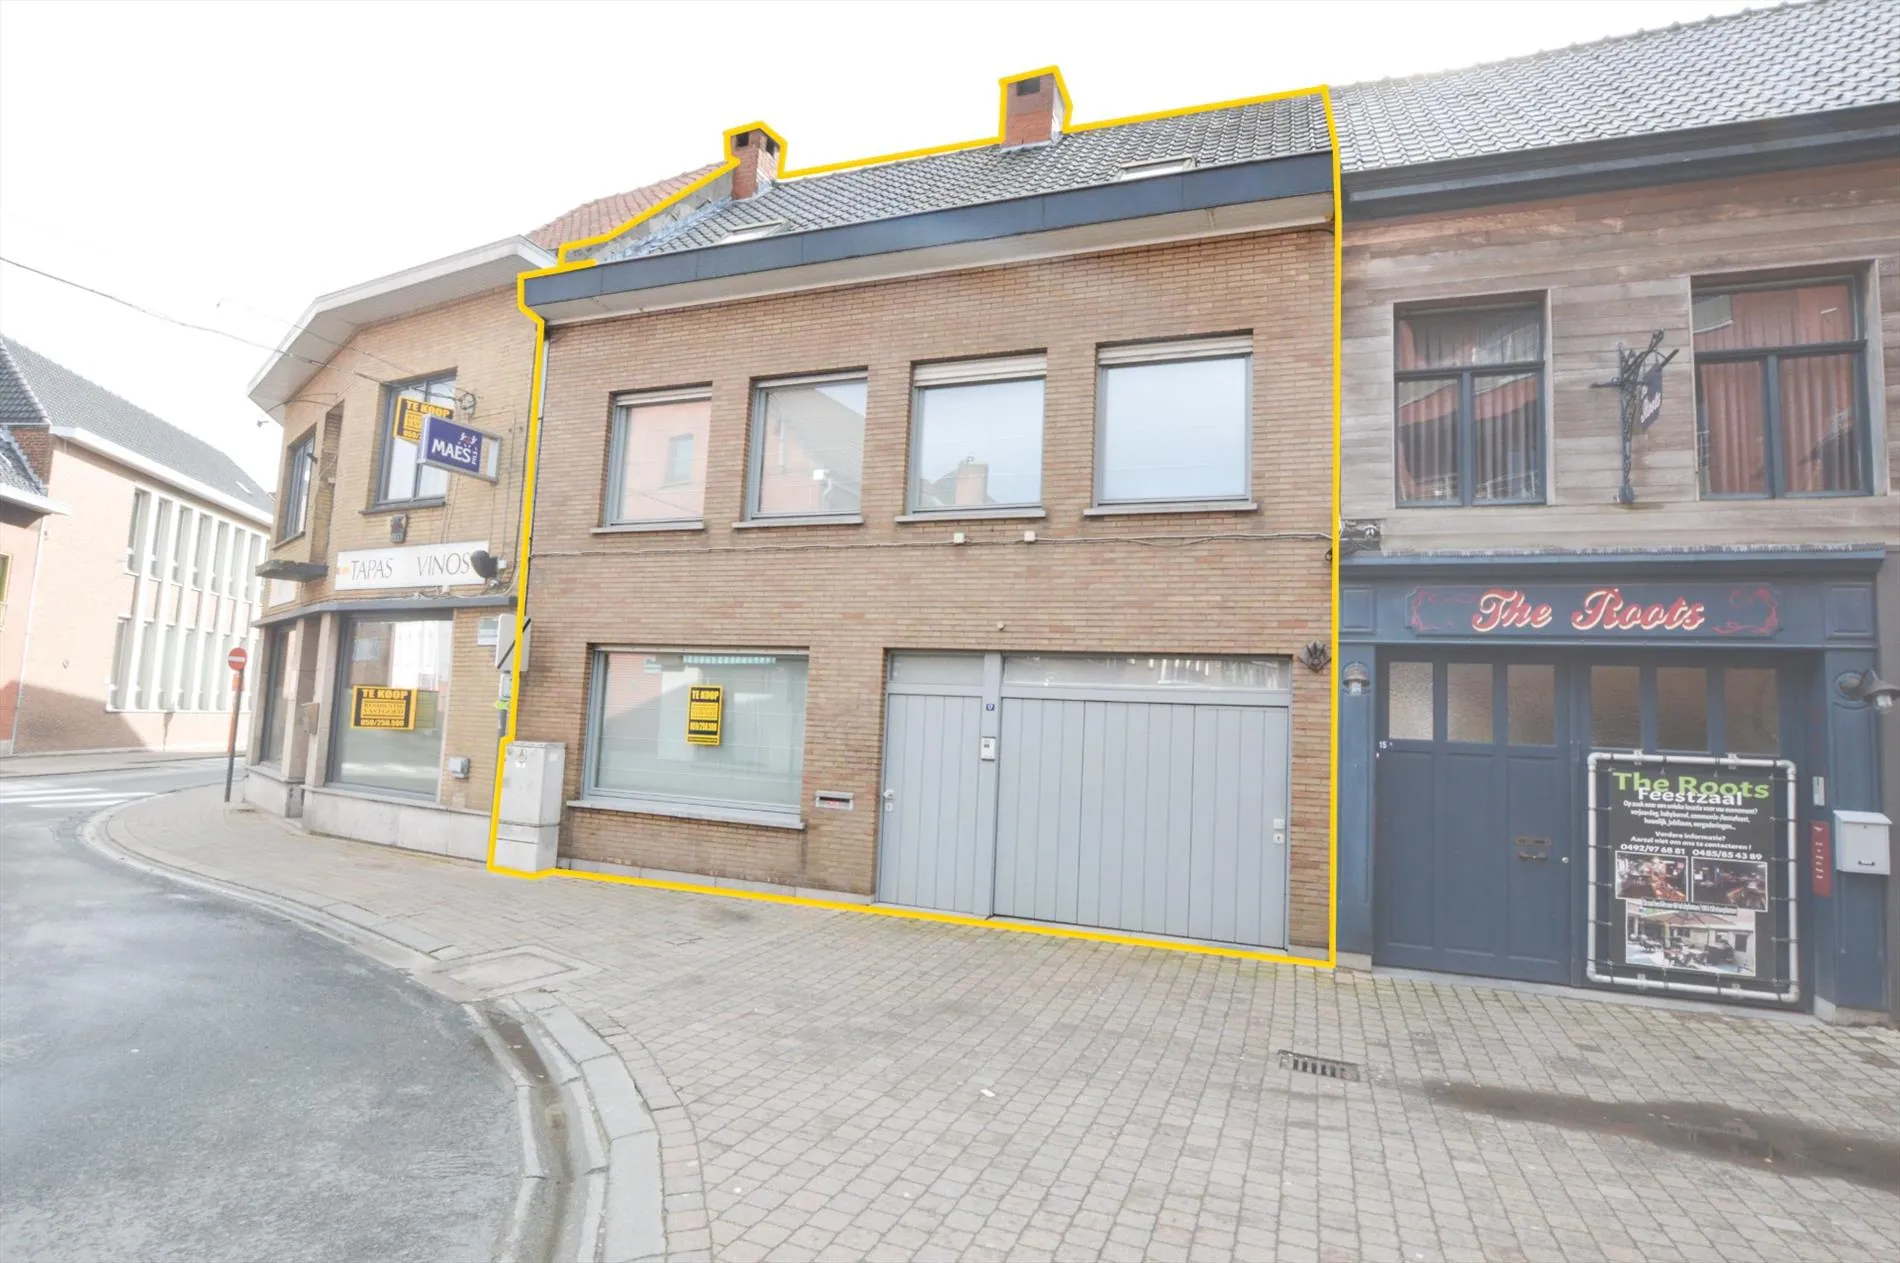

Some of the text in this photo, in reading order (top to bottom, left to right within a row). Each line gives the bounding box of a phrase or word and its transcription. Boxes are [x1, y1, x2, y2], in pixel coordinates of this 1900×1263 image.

[406, 400, 451, 418] TE KOOP
[431, 438, 471, 463] MAES
[351, 552, 470, 580] TAPAS VINOS
[1472, 587, 1706, 632] The Roots
[361, 688, 408, 699] TE KOOP
[1612, 771, 1770, 798] The Roots
[1638, 786, 1742, 806] Feestzaal
